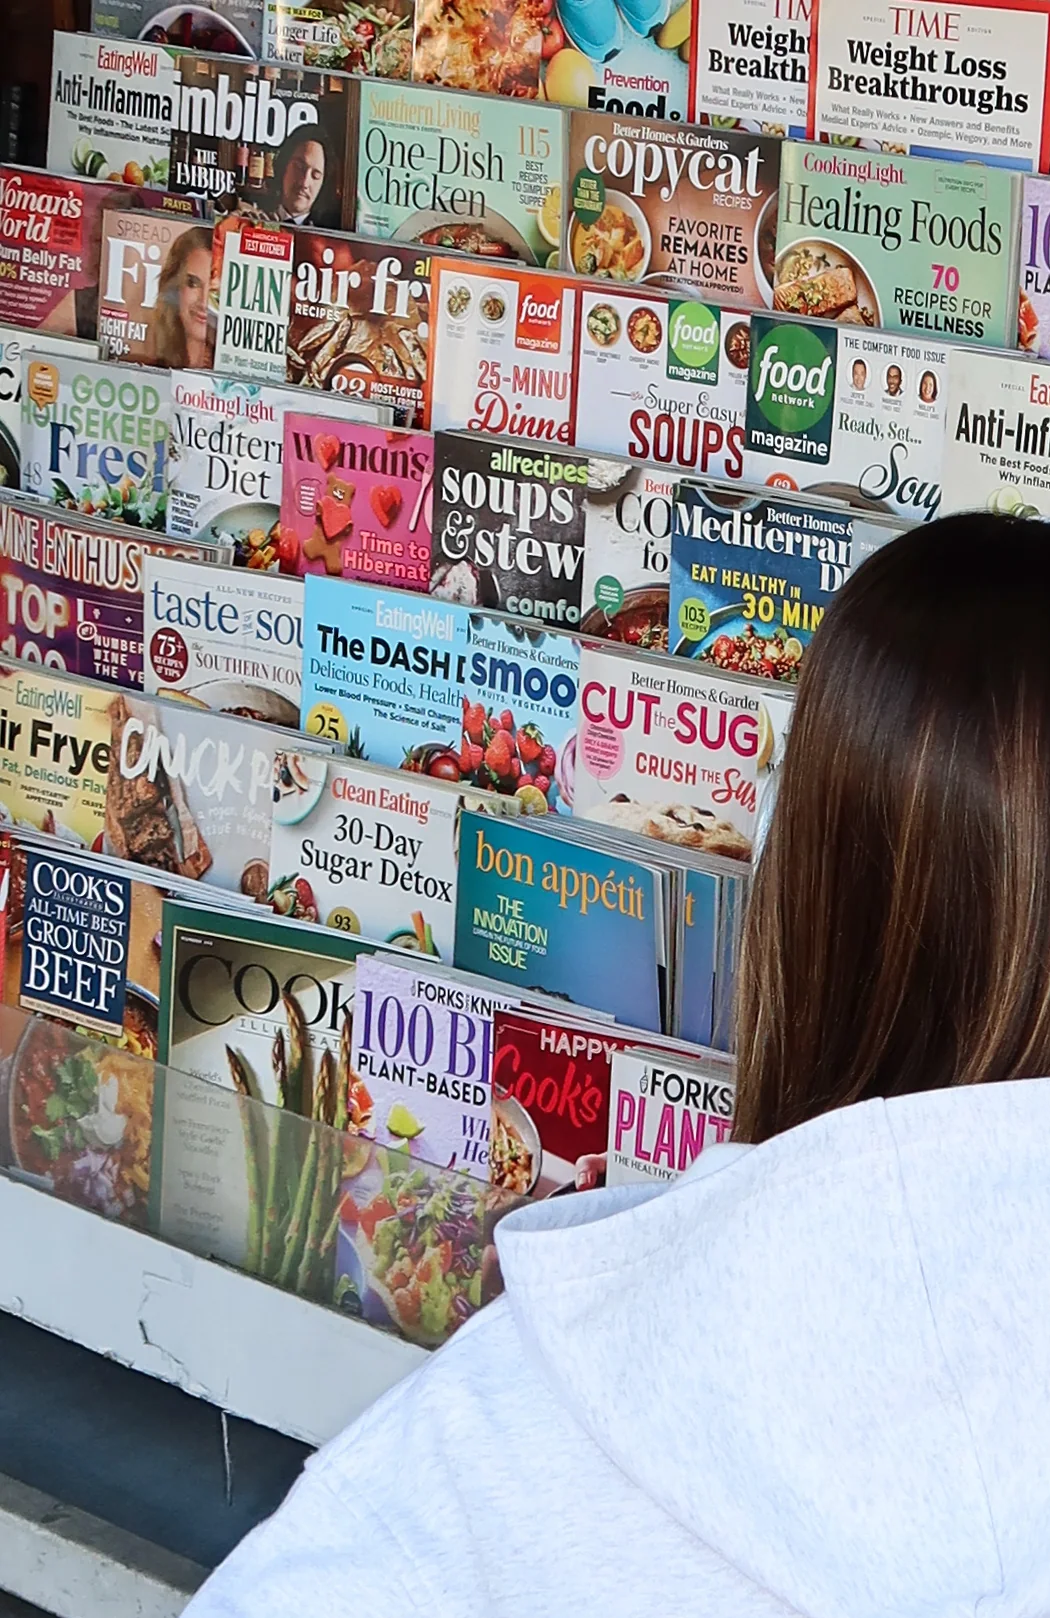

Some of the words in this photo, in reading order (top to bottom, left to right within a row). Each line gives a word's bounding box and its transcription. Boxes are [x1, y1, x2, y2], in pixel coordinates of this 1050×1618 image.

[889, 7, 961, 41] TIME
[98, 45, 158, 78] EatingWell
[848, 39, 936, 72] Weight
[946, 52, 1007, 81] Loss
[56, 71, 172, 122] Anti-Inflamma
[604, 69, 669, 93] Prevention
[828, 66, 1029, 115] Breakthroughs
[173, 74, 318, 147] imbibe
[832, 103, 849, 115] What
[852, 106, 874, 119] Really
[876, 110, 900, 121] Works
[910, 114, 925, 124] New
[928, 116, 964, 129] Answers
[966, 121, 982, 131] and
[985, 121, 1020, 135] Benefits
[365, 127, 504, 183] One-Dish
[518, 126, 550, 158] 115
[519, 171, 548, 184] RECIPES
[526, 161, 544, 172] BEST
[584, 134, 764, 202] copycat
[804, 152, 907, 185] CookingLight
[365, 166, 487, 218] Chicken
[713, 194, 752, 210] RECIPES
[669, 217, 743, 242] FAVORITE
[782, 181, 902, 252] Healing
[909, 200, 1001, 256] Foods
[661, 237, 748, 264] REMAKES
[668, 261, 686, 277] AT
[691, 265, 738, 283] HOME
[931, 264, 959, 294] 70
[295, 303, 341, 323] RECIPES
[519, 294, 561, 323] food
[894, 288, 958, 314] RECIPES
[962, 299, 991, 318] FOR
[672, 315, 718, 346] food
[900, 308, 984, 339] WELLNESS
[516, 337, 560, 352] magazine
[844, 337, 860, 350] THE
[863, 339, 898, 357] COMFORT
[901, 346, 921, 361] FOOD
[924, 351, 946, 364] ISSUE
[668, 365, 717, 383] magazine
[754, 345, 832, 401] food
[72, 375, 159, 415] GOOD
[175, 384, 276, 424] CookingLight
[644, 383, 694, 418] Super
[697, 392, 739, 429] Easy
[772, 393, 815, 409] network
[629, 409, 745, 478] SOUPS
[751, 429, 828, 458] magazine
[206, 454, 271, 500] Diet
[491, 449, 589, 486] allrecipes
[980, 453, 997, 467] The
[1000, 456, 1021, 471] Best
[999, 471, 1021, 485] Why
[441, 466, 575, 533] soups
[359, 529, 404, 556] Time
[409, 539, 430, 559] to
[691, 563, 716, 584] EAT
[722, 568, 787, 597] HEALTHY
[377, 600, 454, 642] EatingWell
[317, 624, 365, 661] The
[370, 636, 449, 680] DASH
[471, 652, 576, 707] smoo
[16, 680, 82, 719] EatingWell
[581, 682, 661, 735] CUT
[654, 714, 676, 730] the
[675, 703, 758, 758] SUG
[636, 752, 698, 786] CRUSH
[701, 769, 721, 784] THE
[334, 814, 423, 867] 30-Day
[32, 862, 124, 917] COOK'S
[301, 839, 372, 885] Sugar
[379, 859, 453, 904] Detox
[476, 830, 534, 887] bon
[541, 860, 644, 922] appétit
[28, 898, 89, 928] ALL-TIME
[91, 916, 126, 937] BEST
[497, 894, 524, 919] THE
[27, 917, 124, 966] GROUND
[473, 908, 548, 946] INNOVATION
[488, 941, 527, 970] ISSUE
[25, 944, 121, 1014] BEEF
[417, 981, 464, 1011] FORKS
[358, 989, 434, 1068] 100
[540, 1028, 618, 1064] HAPPY
[358, 1053, 487, 1108] PLANT-BASED
[493, 1043, 603, 1127] Cook's
[650, 1069, 734, 1118] FORKS
[614, 1154, 630, 1167] THE
[631, 1160, 673, 1181] HEALTHY
